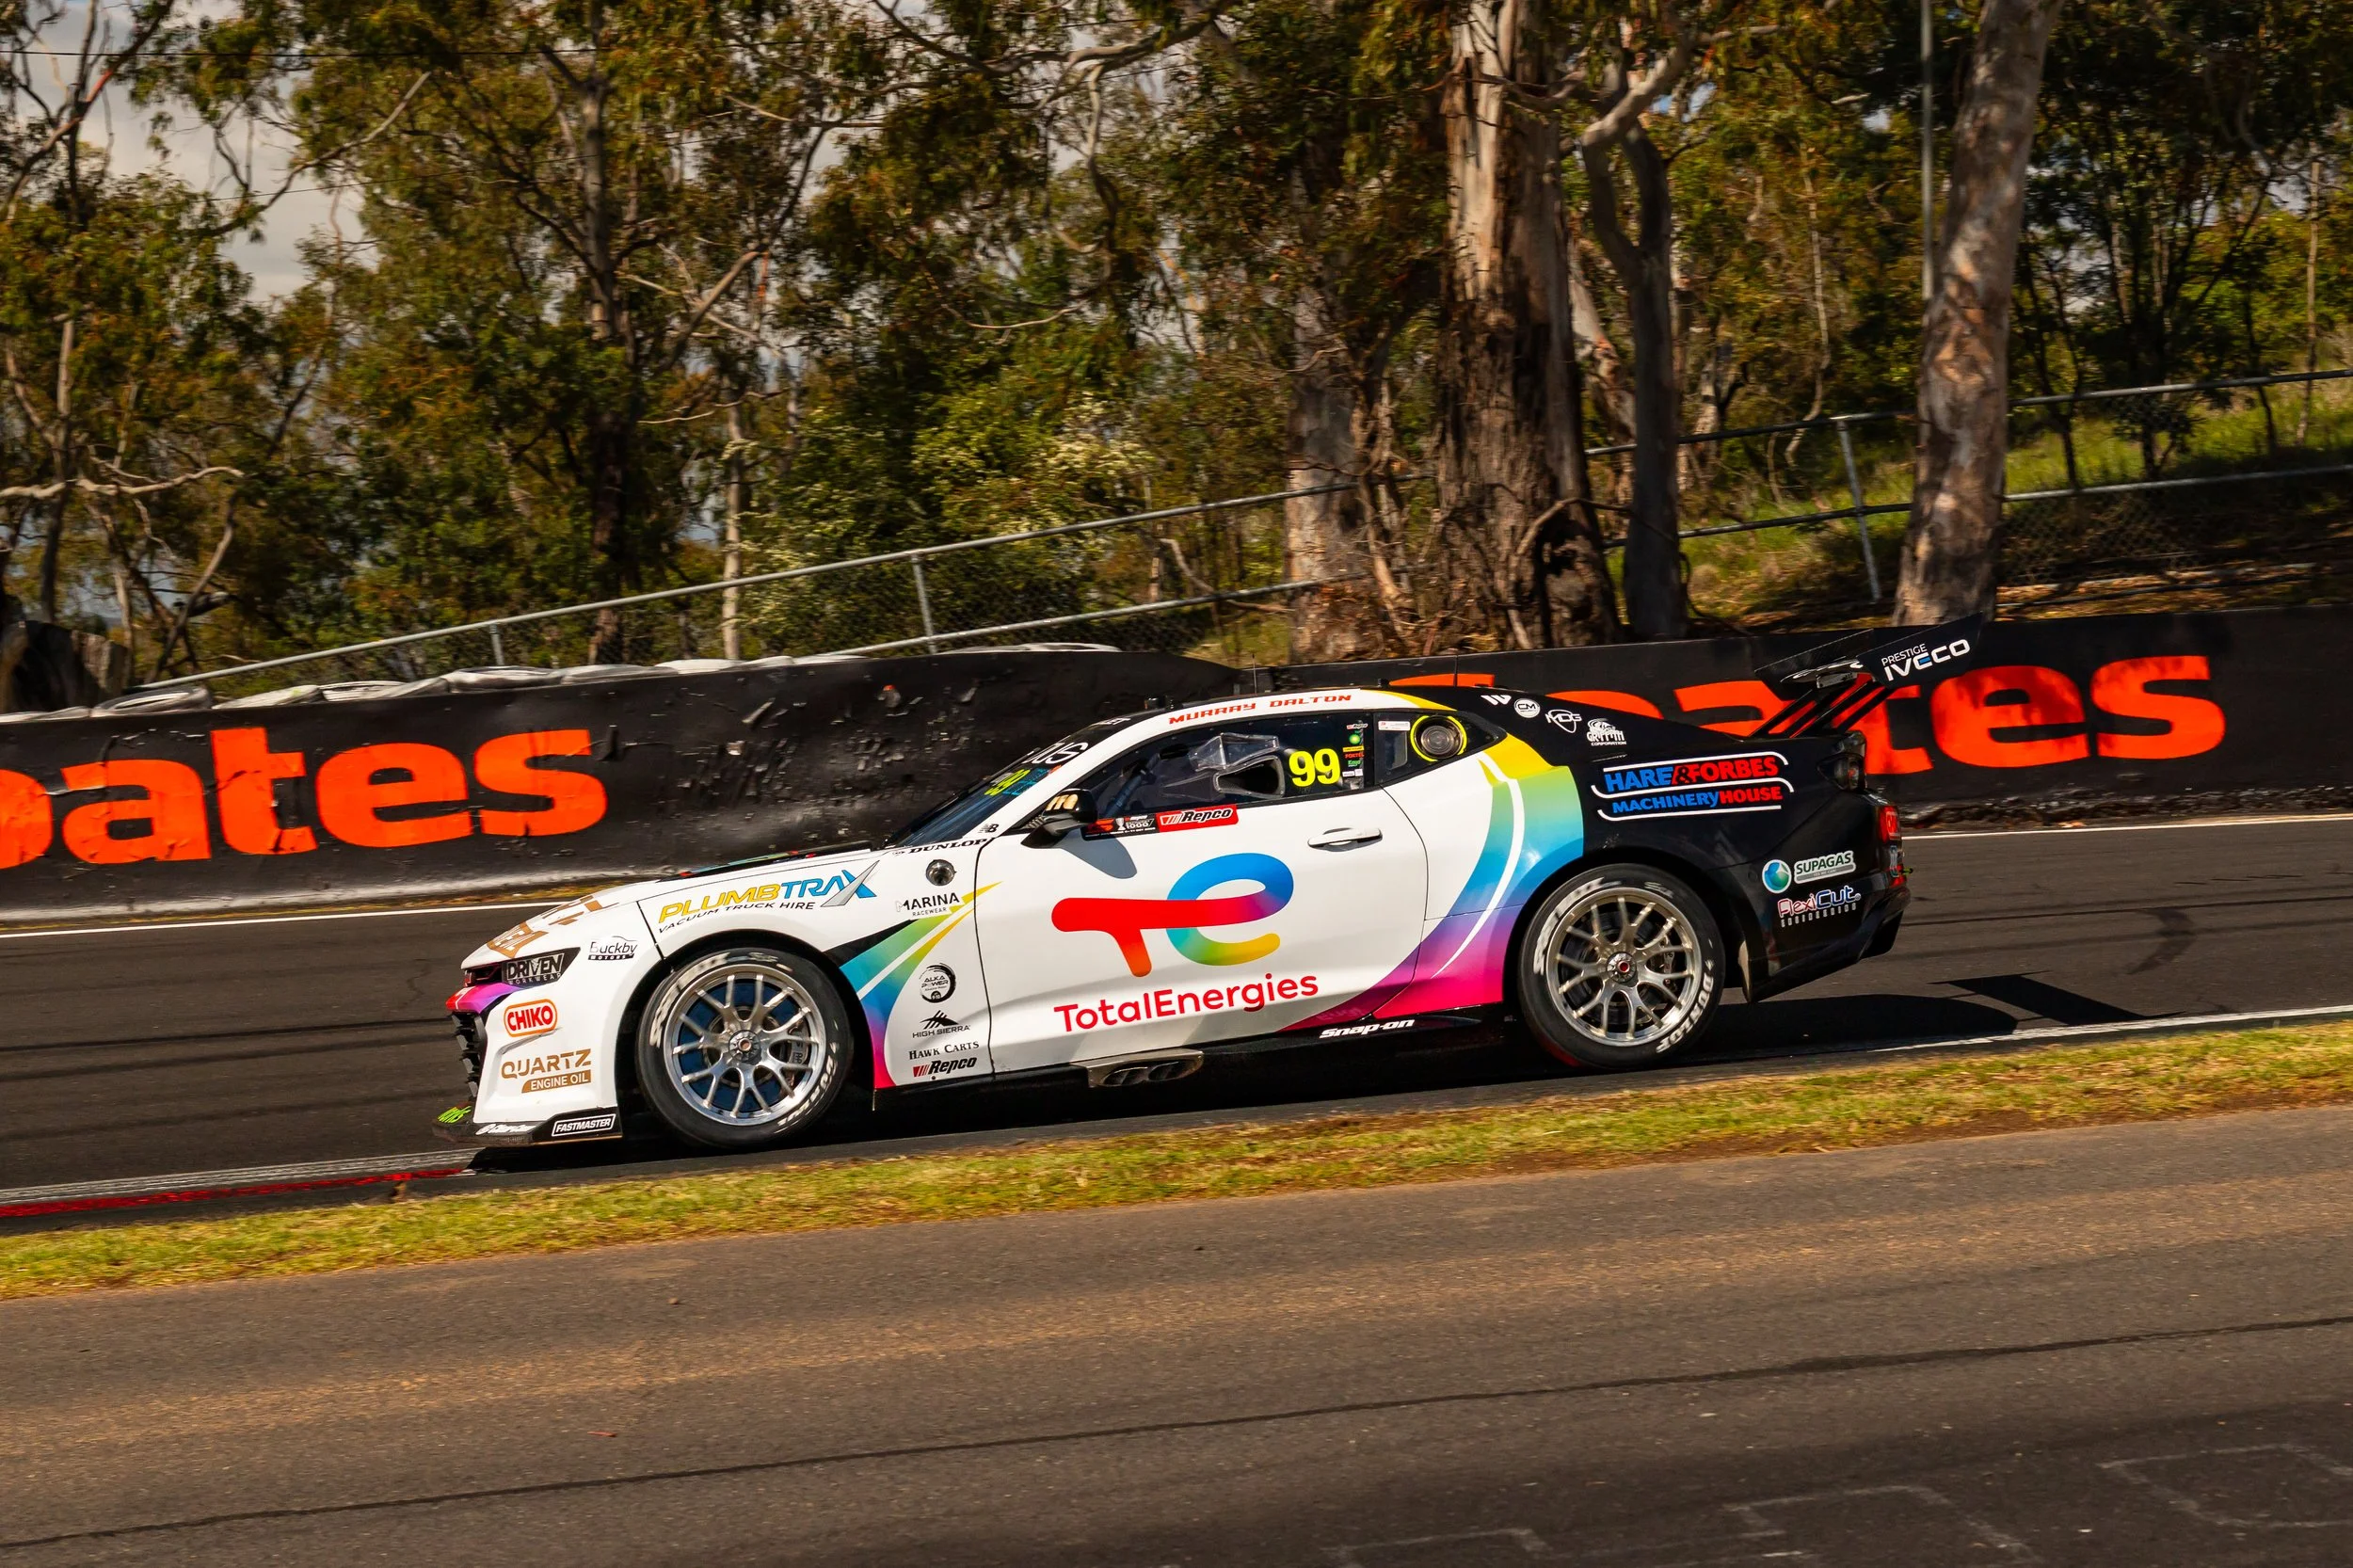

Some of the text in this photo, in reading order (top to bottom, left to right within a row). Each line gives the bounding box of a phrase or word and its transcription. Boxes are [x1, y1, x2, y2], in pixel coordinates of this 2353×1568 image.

[1881, 644, 1927, 666] PRESTIGE
[1883, 639, 1971, 681] IVECO
[1168, 695, 1353, 725] MURRAY DALTON
[1288, 748, 1341, 787] 99
[1181, 808, 1233, 824] Repco
[908, 839, 987, 854] DUNLOP
[1796, 852, 1851, 875] SUPAGAS
[657, 860, 881, 924] PLUMBTRAX
[896, 892, 959, 912] MARINA
[658, 902, 816, 934] VACUUM TRUCK HIRE
[912, 906, 947, 917] RACEWEAR
[589, 941, 638, 955] Buckby
[507, 954, 564, 980] DRIVEN
[1054, 972, 1319, 1032] TotalEnergies
[507, 1005, 553, 1032] CHIKO
[936, 1025, 969, 1034] SIERRA
[908, 1040, 980, 1060] HAWK CARTS
[502, 1048, 591, 1080] QUARTZ
[928, 1057, 978, 1075] Repco
[531, 1073, 589, 1091] ENGINE OIL
[556, 1118, 611, 1133] FASTMASTER
